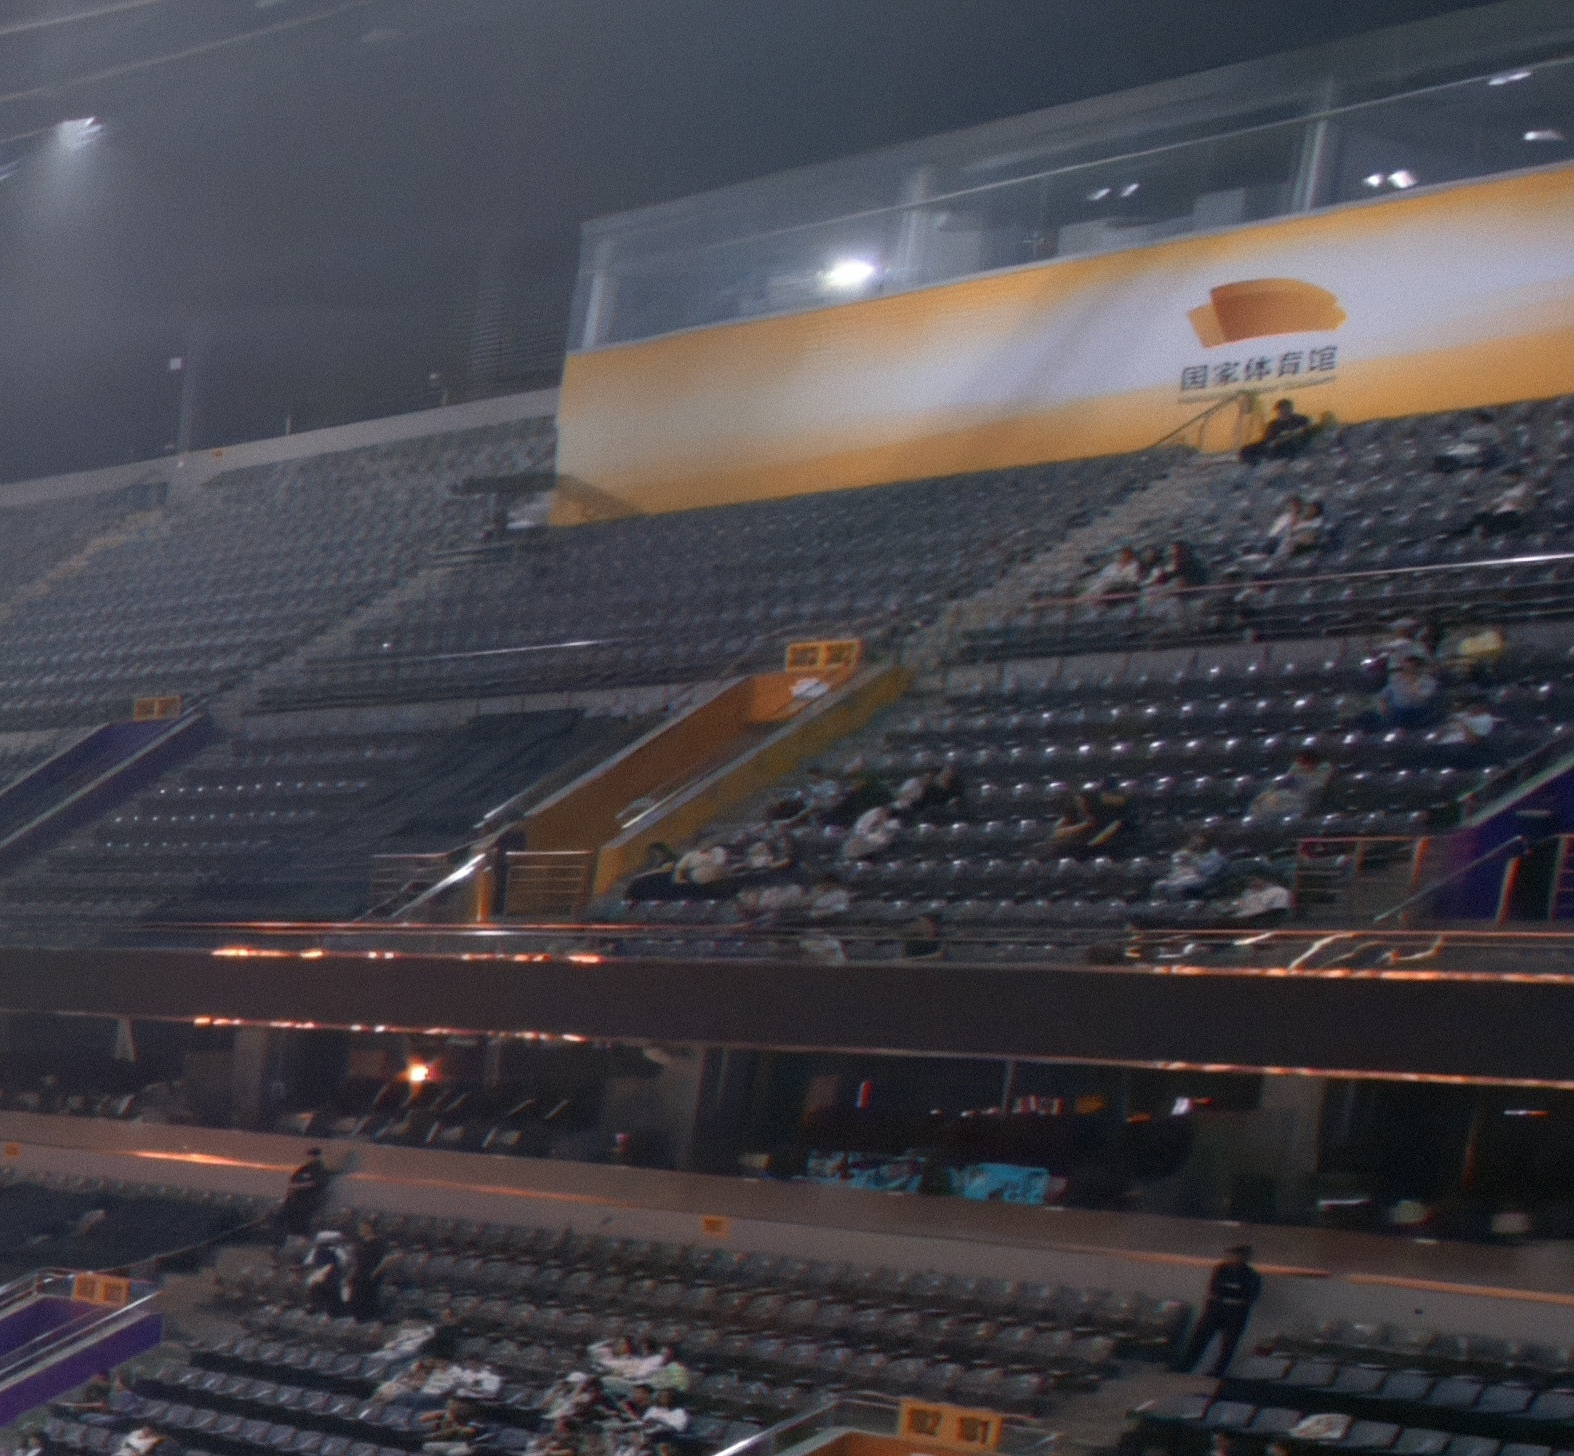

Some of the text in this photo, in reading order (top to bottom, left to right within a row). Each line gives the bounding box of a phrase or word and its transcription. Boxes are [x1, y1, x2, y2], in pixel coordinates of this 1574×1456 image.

[1182, 344, 1338, 391] 国家体育馆
